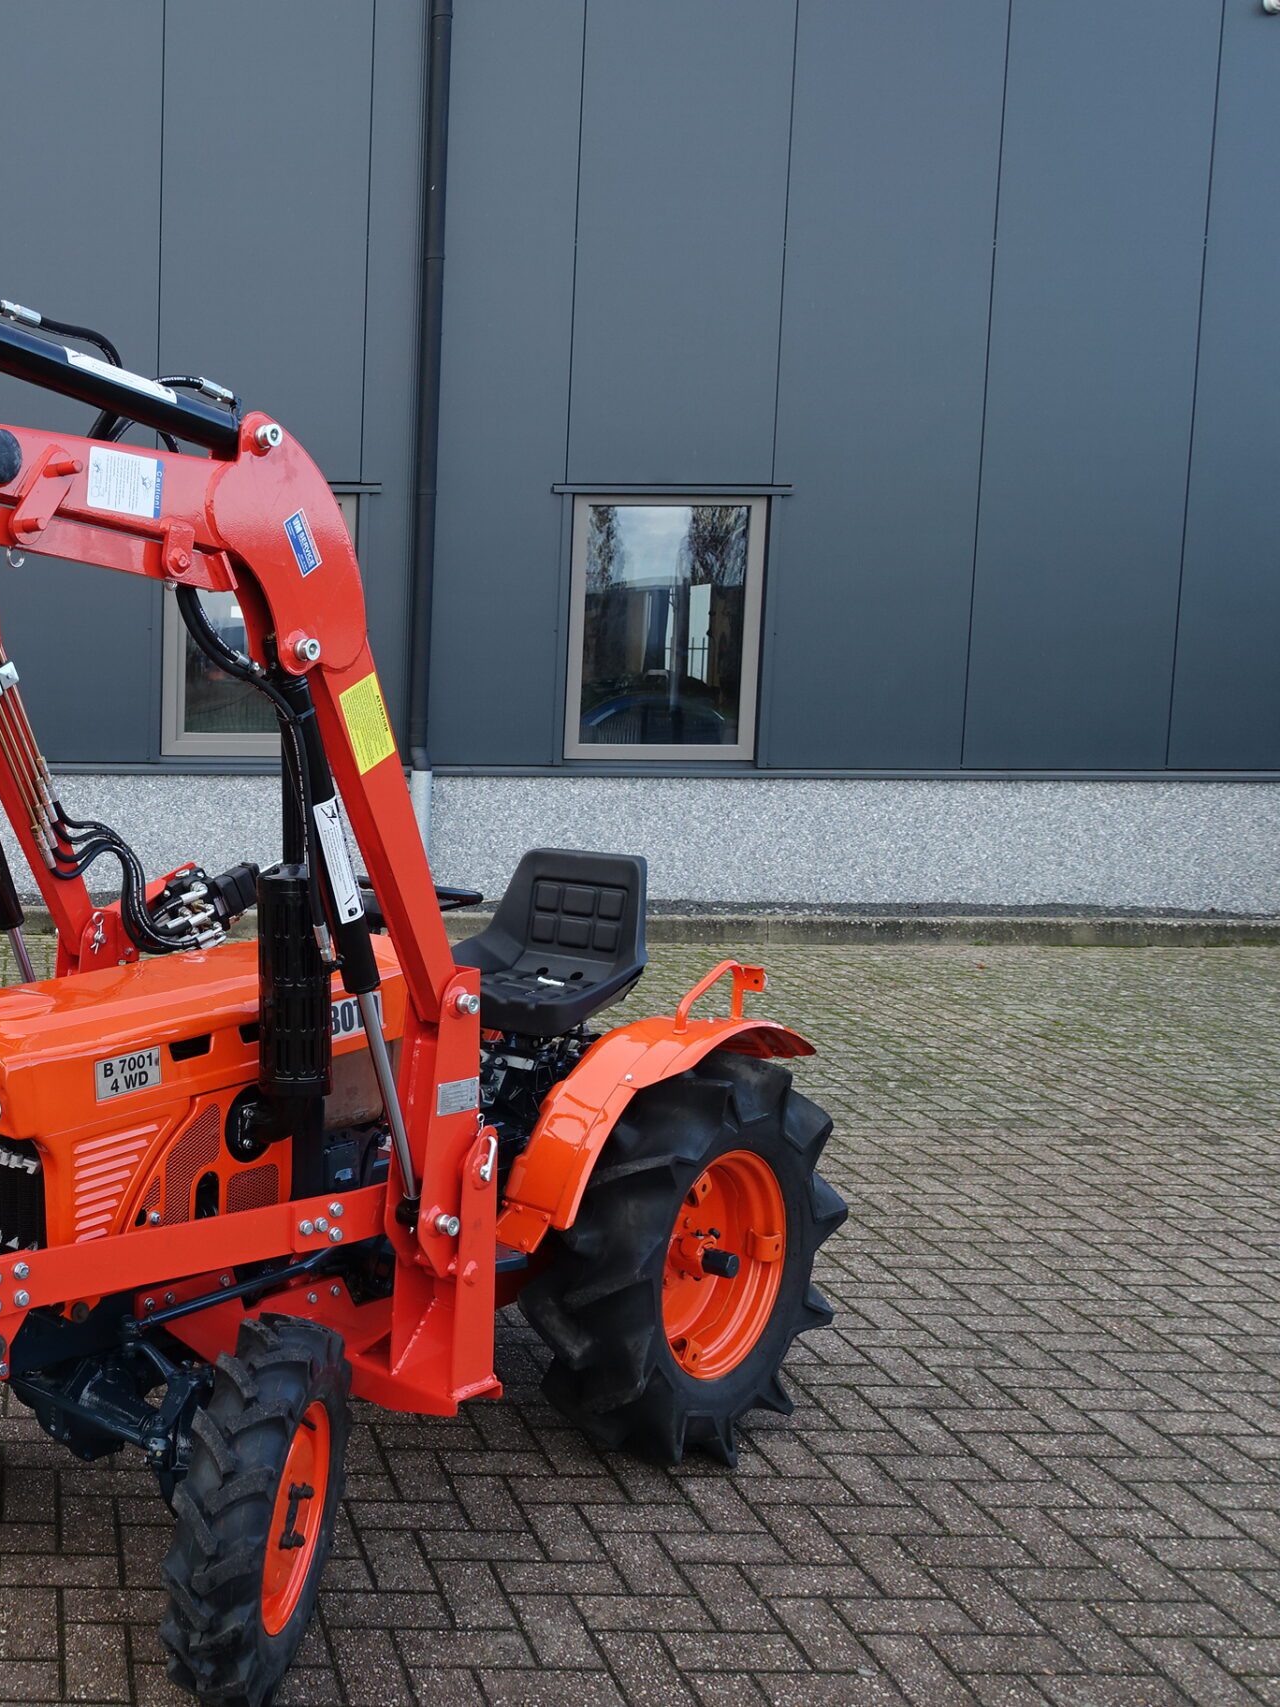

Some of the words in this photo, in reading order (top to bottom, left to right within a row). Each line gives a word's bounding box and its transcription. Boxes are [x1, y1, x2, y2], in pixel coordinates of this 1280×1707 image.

[298, 531, 316, 568] SERVICE
[331, 994, 380, 1036] BOT
[103, 1062, 114, 1078] B
[119, 1052, 153, 1074] 7001
[110, 1078, 120, 1093] 4
[123, 1070, 149, 1090] WD
